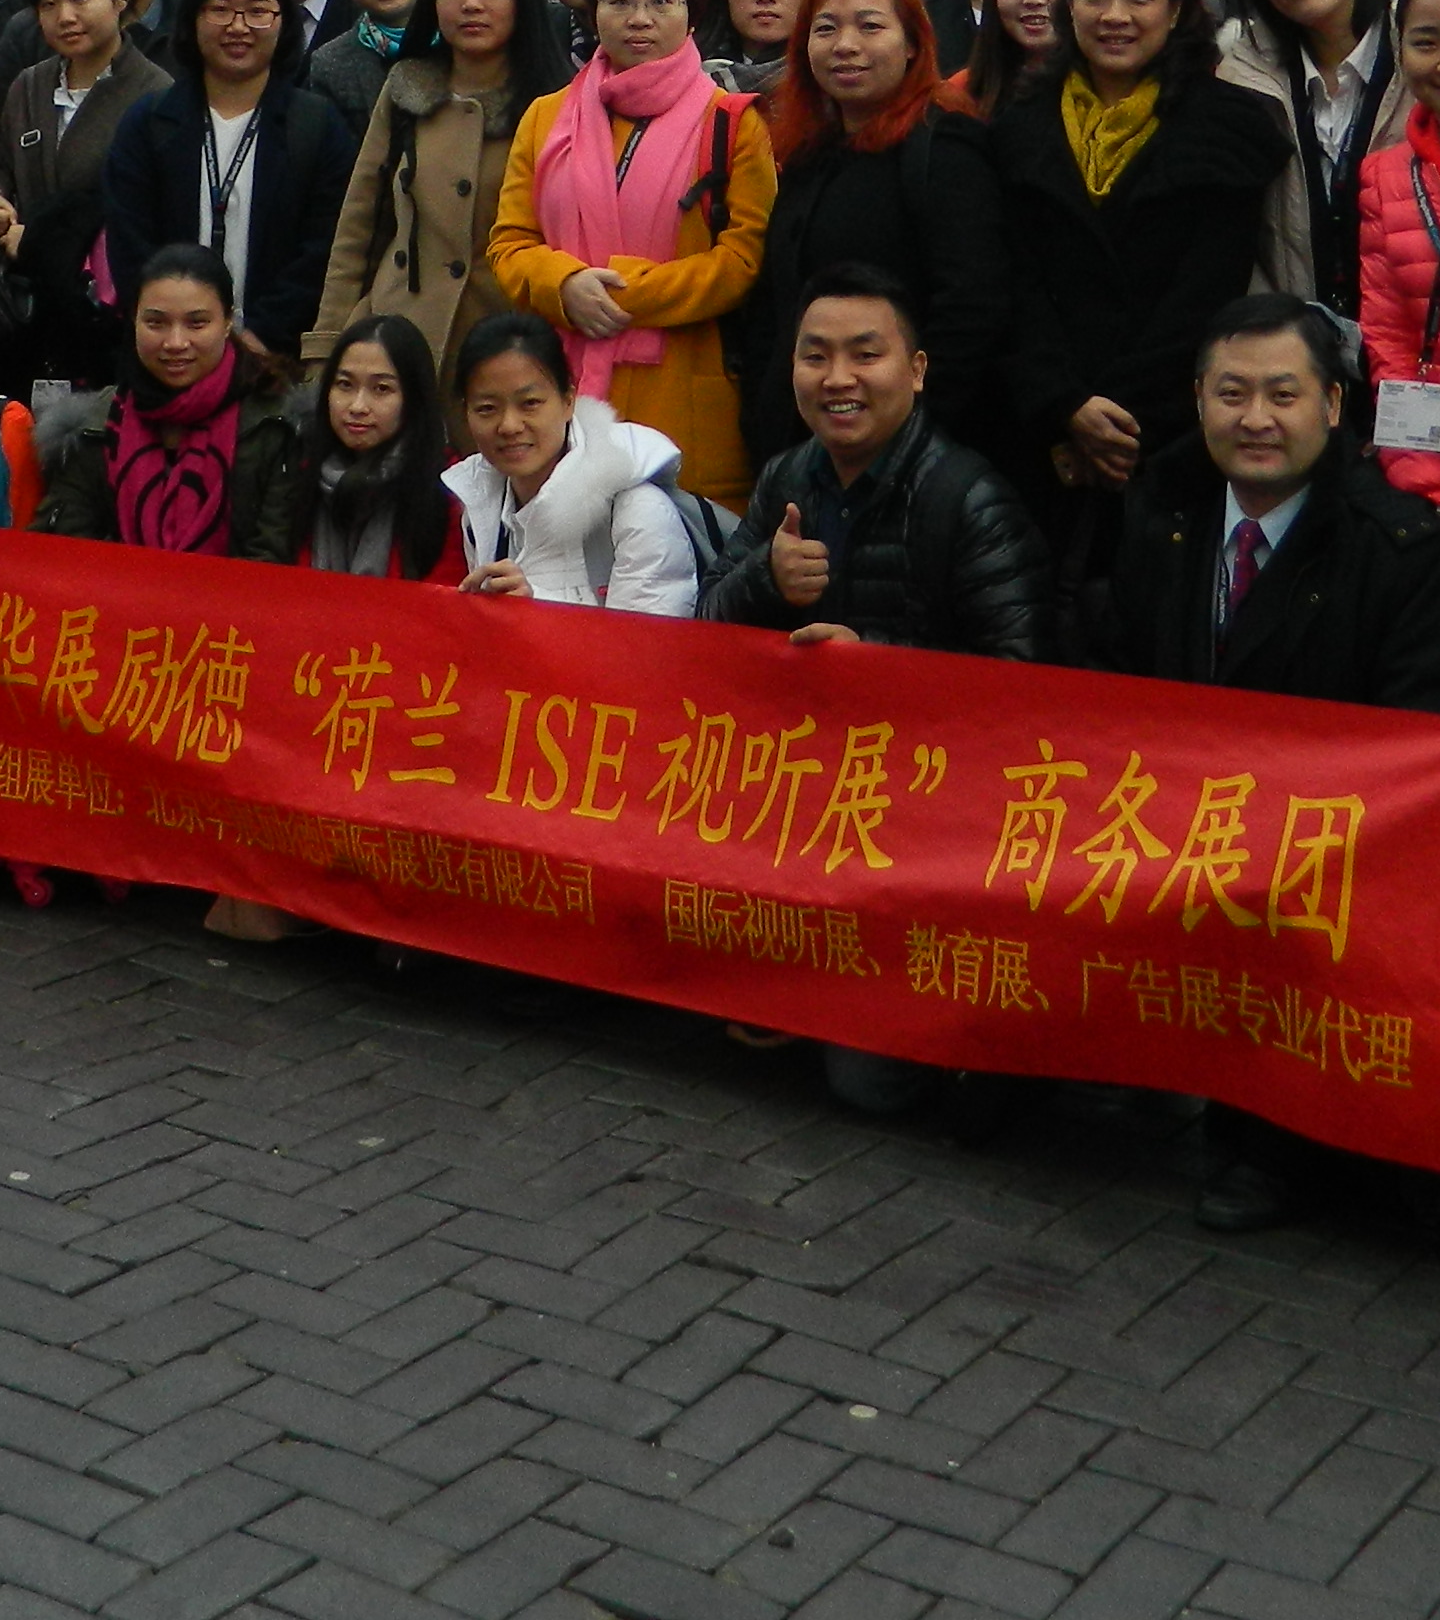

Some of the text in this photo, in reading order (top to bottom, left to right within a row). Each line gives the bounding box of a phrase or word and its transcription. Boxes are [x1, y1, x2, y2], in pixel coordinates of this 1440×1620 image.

[293, 640, 462, 794] “荷兰
[485, 688, 638, 821] ISE
[646, 697, 948, 874] 视听展”
[984, 739, 1367, 963] 商务展团
